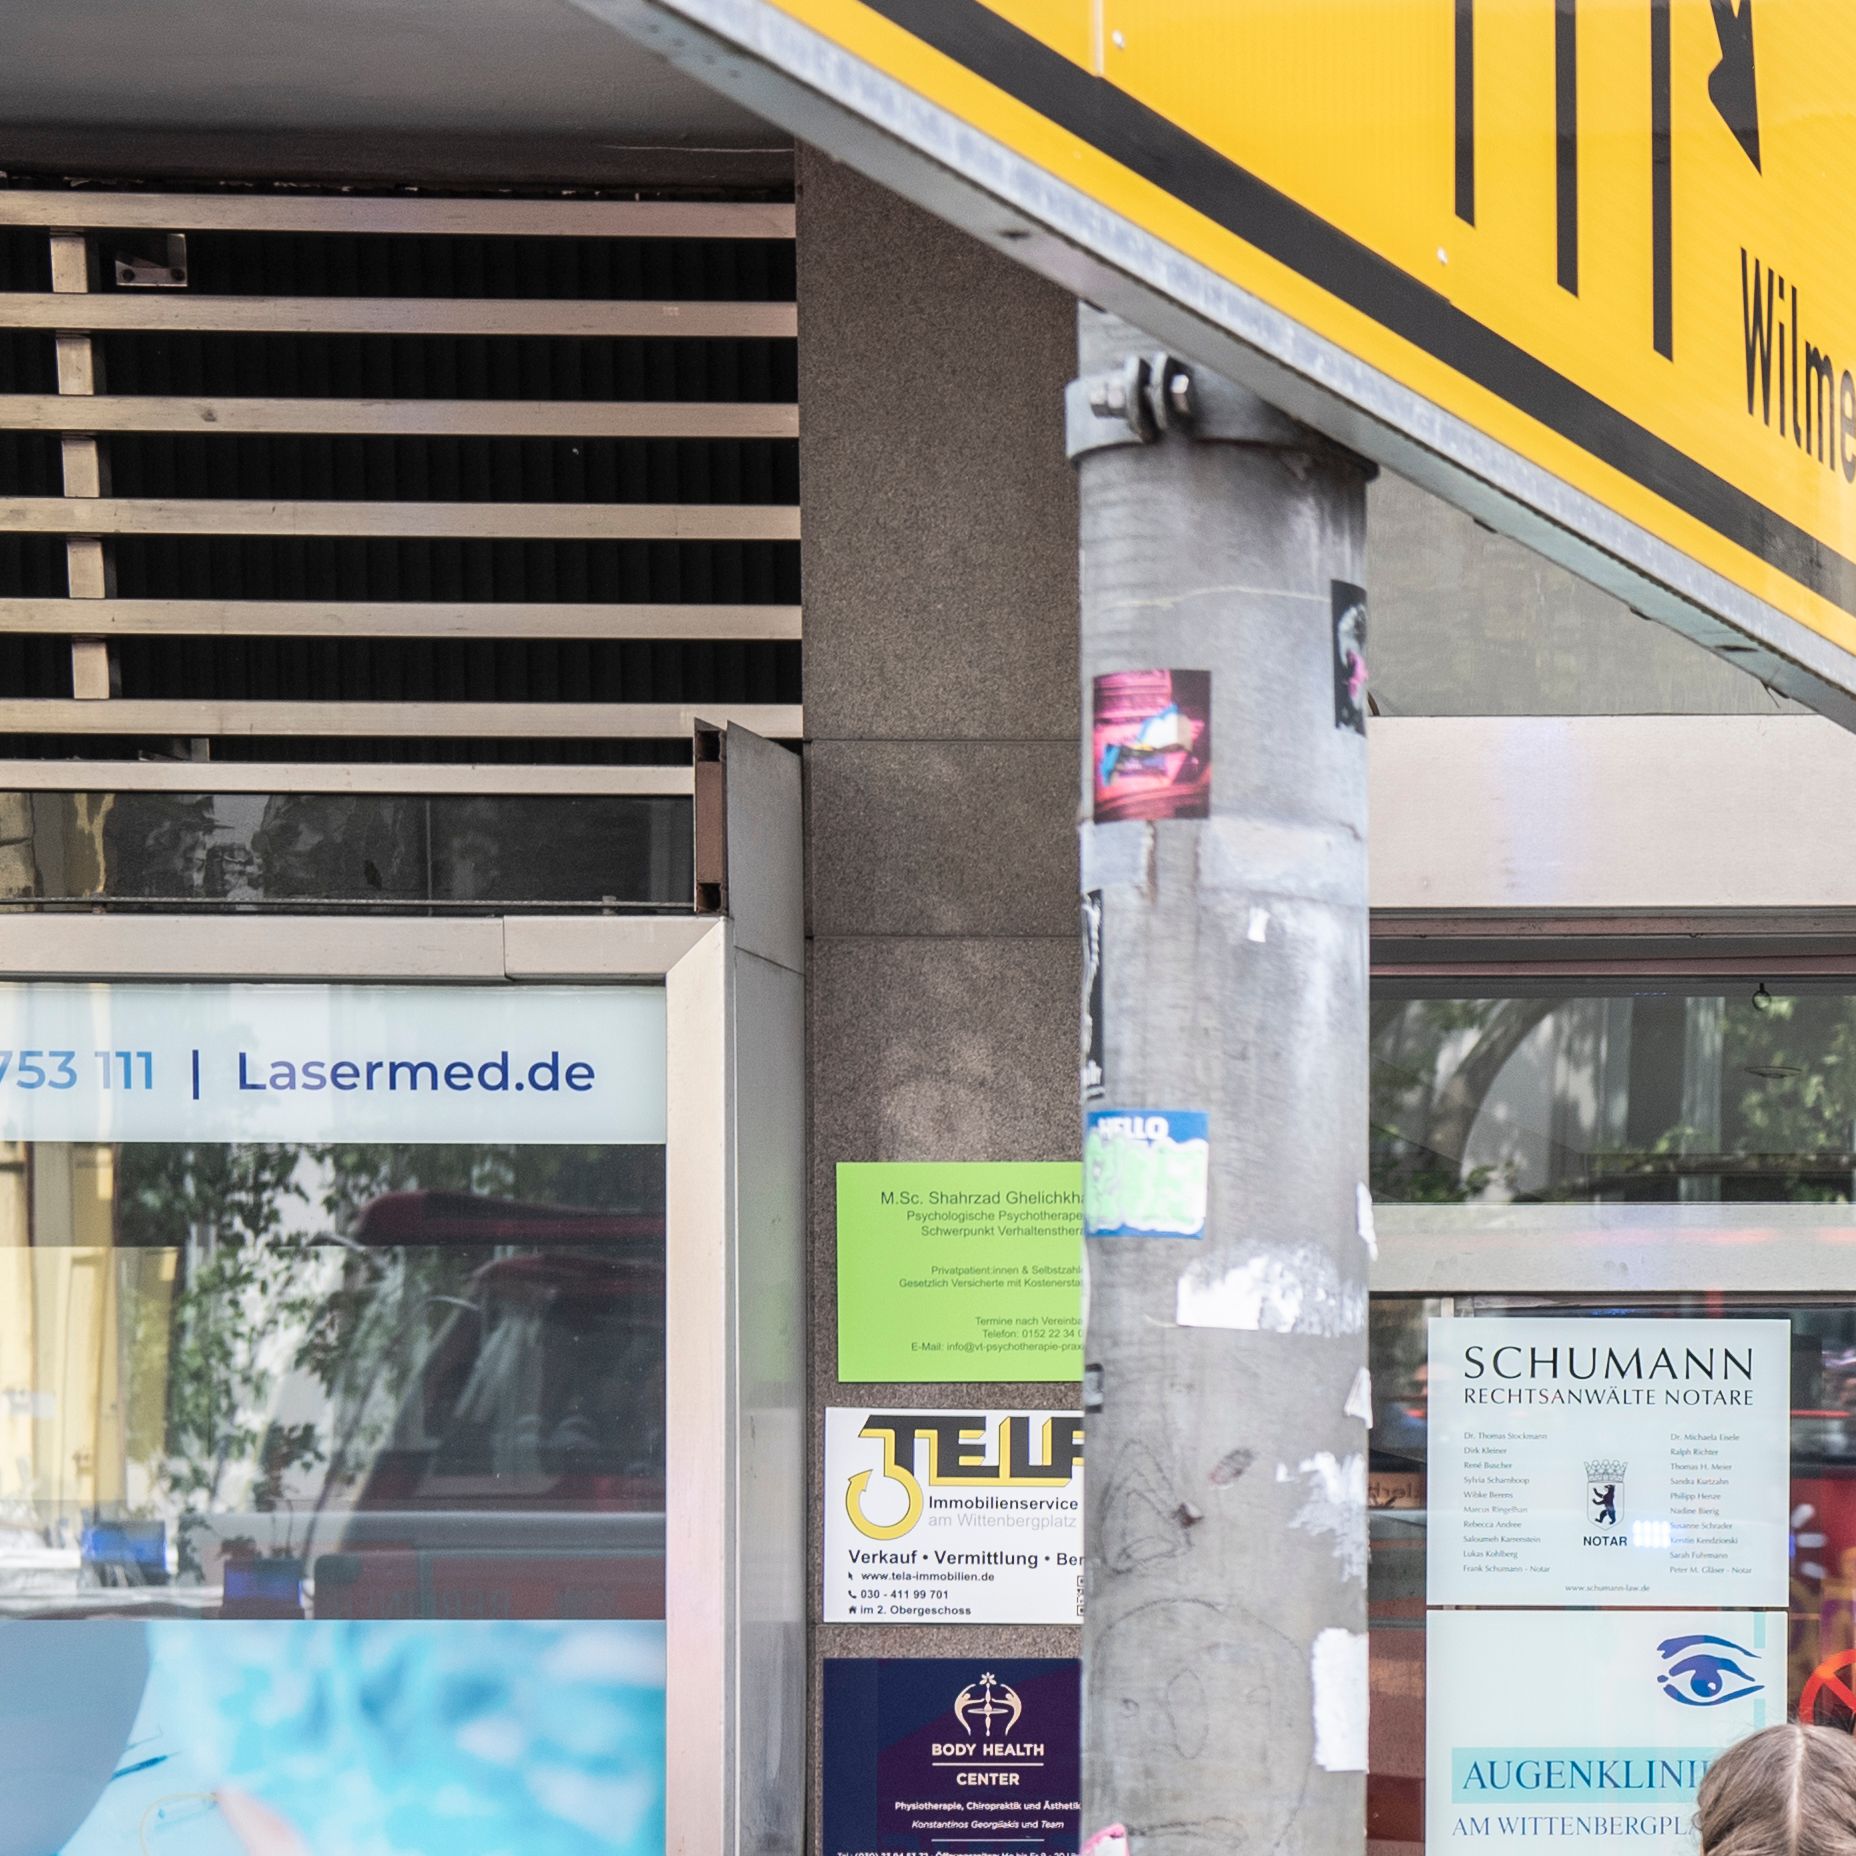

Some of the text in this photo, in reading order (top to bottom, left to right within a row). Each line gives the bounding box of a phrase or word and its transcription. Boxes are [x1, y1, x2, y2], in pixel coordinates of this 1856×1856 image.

[94, 1051, 153, 1090] 111
[238, 1050, 596, 1092] Lasermed.de
[929, 1191, 1000, 1205] Shahrzad
[907, 1210, 995, 1223] Psychologische
[921, 1226, 995, 1239] Schwerpunkt
[1463, 1345, 1753, 1381] SCHUMANN
[1464, 1385, 1754, 1406] RECHTSANWÄLTE NOTARE
[928, 1496, 1079, 1511] Immobilienservice
[928, 1513, 1077, 1530] am Wittenbergplatz
[1583, 1535, 1628, 1547] NOTAR
[848, 1549, 1038, 1568] Verkauf Vermittlung
[861, 1573, 995, 1582] www.tela-immobilien.de
[861, 1590, 948, 1599] 030 411 99 701
[860, 1605, 874, 1615] im
[890, 1605, 971, 1617] Obergeschoss
[931, 1743, 1045, 1757] BODY HEALTH
[956, 1772, 1020, 1786] CENTER
[1452, 1816, 1490, 1837] AM
